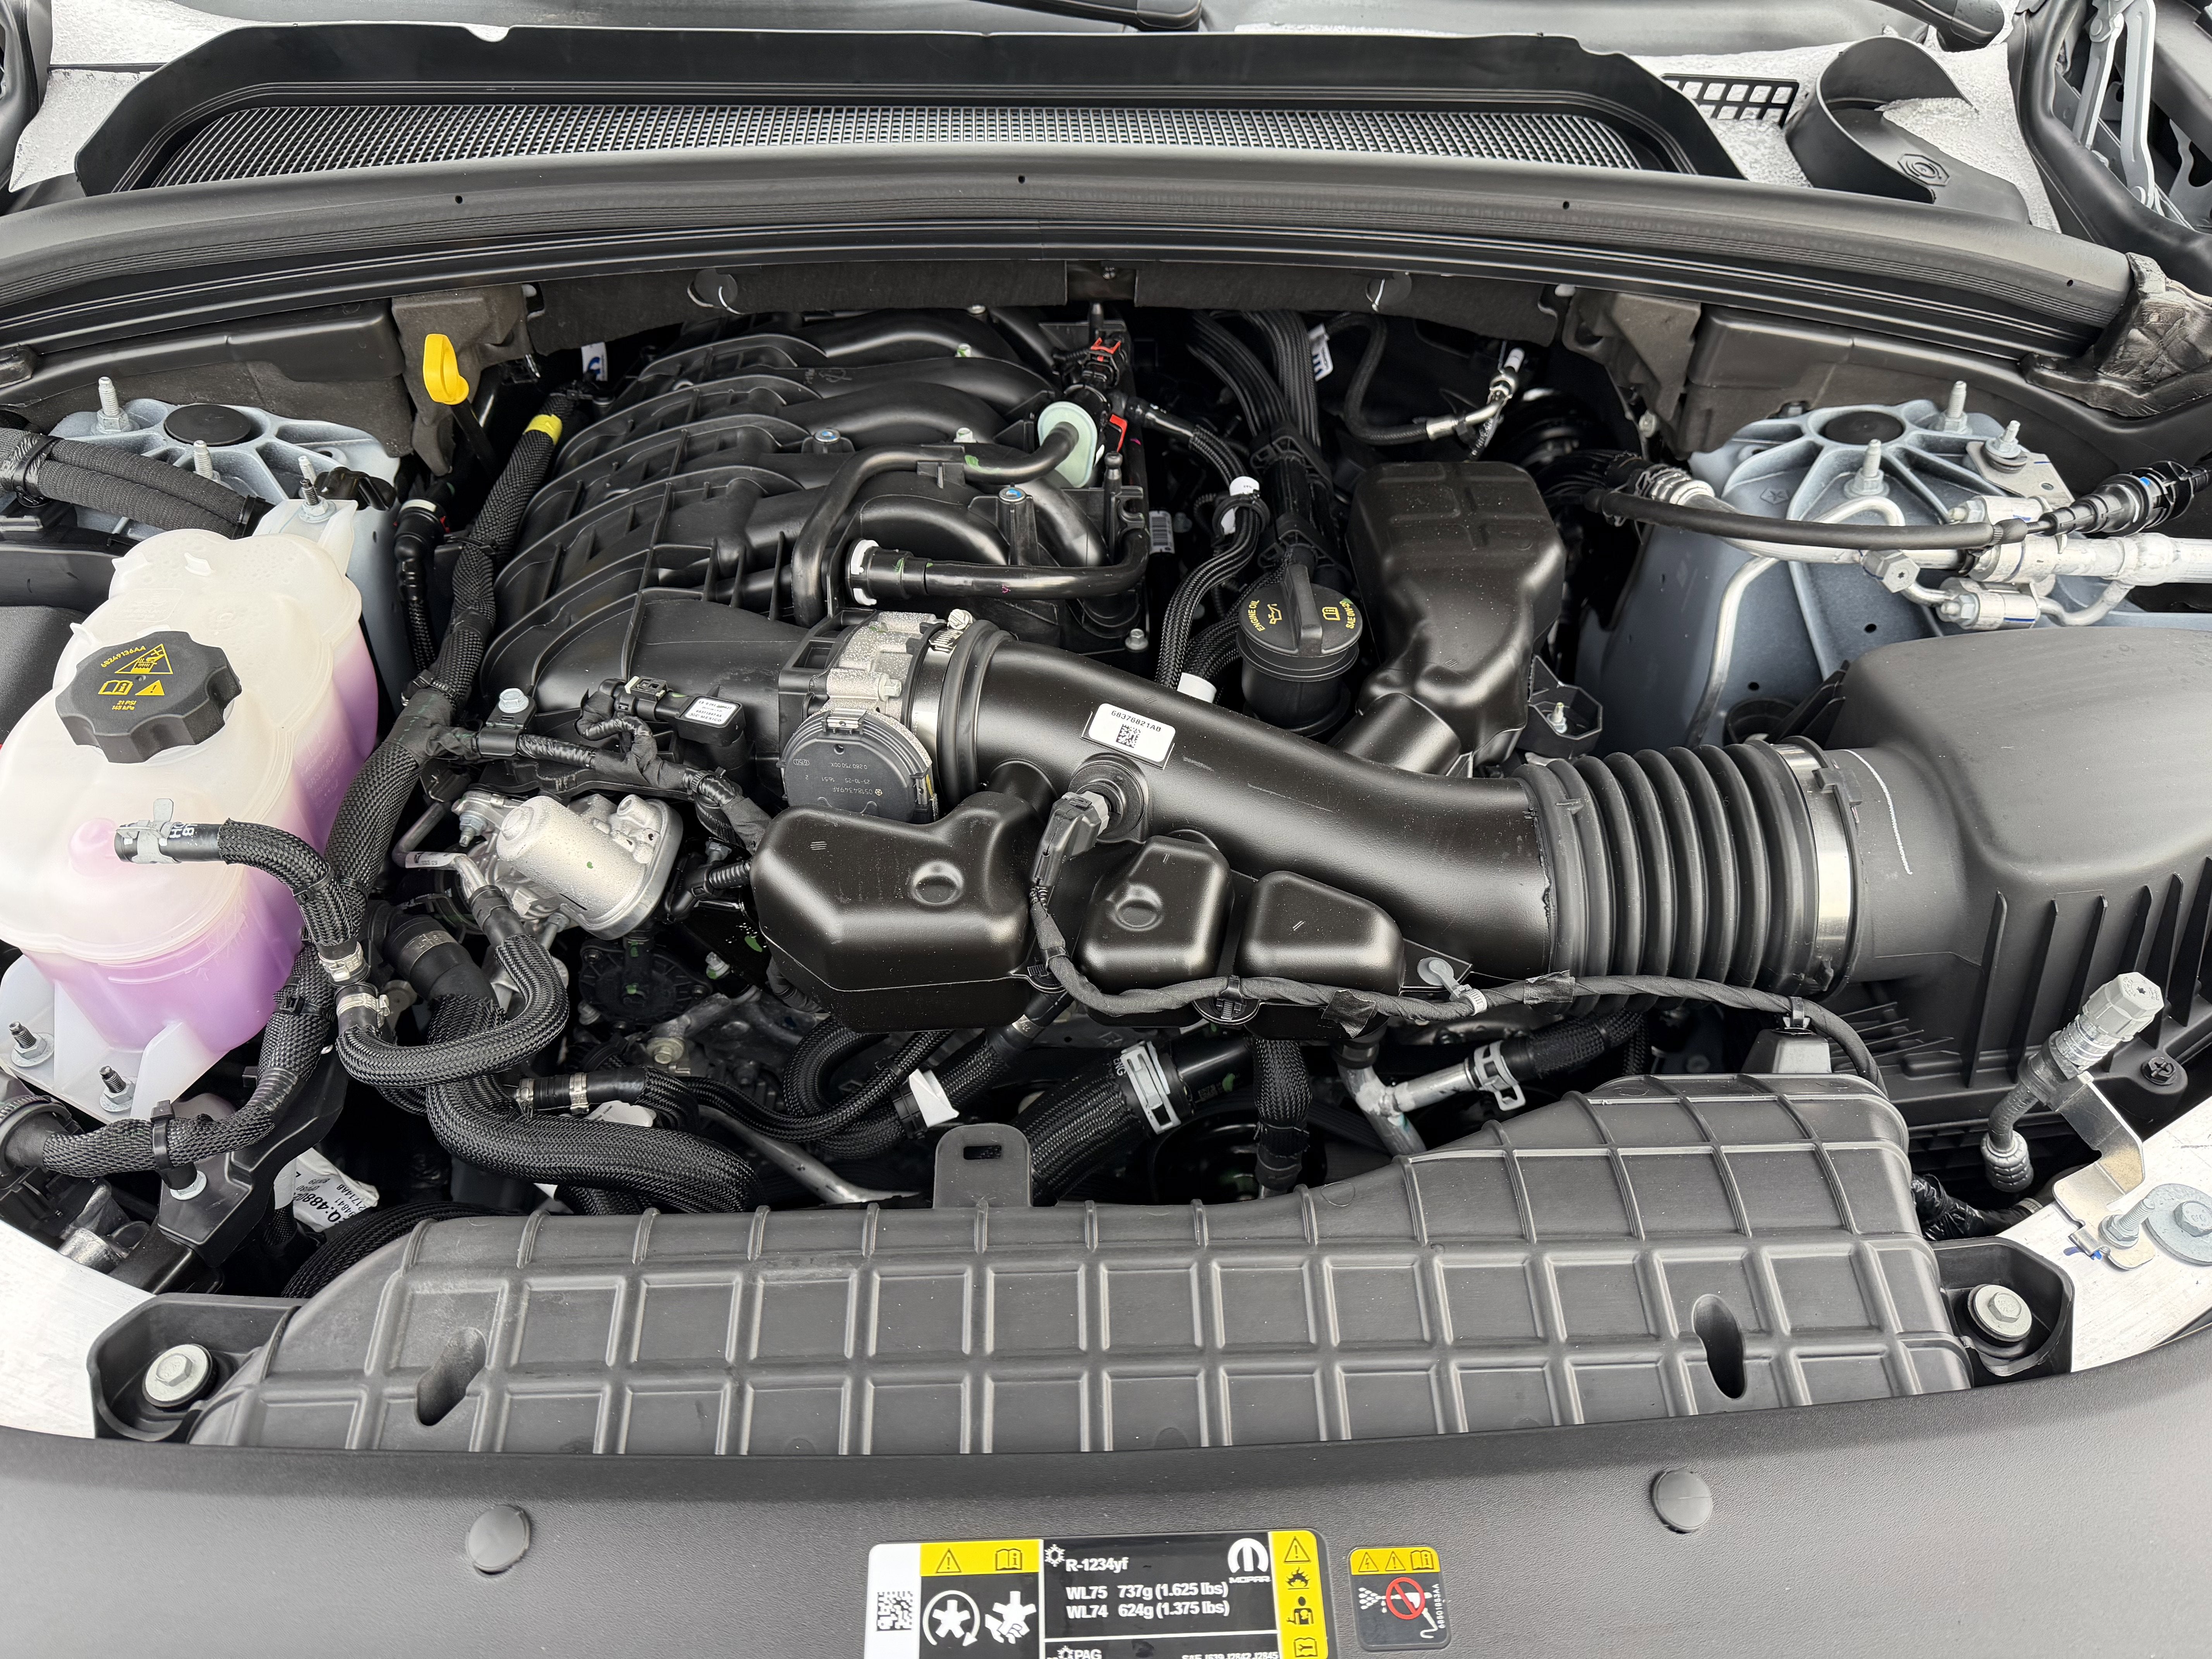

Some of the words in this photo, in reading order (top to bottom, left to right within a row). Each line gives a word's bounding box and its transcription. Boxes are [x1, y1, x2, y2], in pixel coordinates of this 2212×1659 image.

[1249, 600, 1260, 609] OIL
[1248, 610, 1266, 632] ENGINE
[1346, 617, 1356, 629] SAE
[101, 646, 146, 668] 68249136AA
[1111, 710, 1161, 732] 68376821AB
[1066, 1557, 1129, 1573] R-1234yf
[1066, 1586, 1108, 1600] WL75
[1117, 1585, 1153, 1601] 737g
[1155, 1583, 1199, 1600] (1.625
[1201, 1582, 1229, 1598] lbs)
[1066, 1605, 1108, 1619] WL74
[1118, 1603, 1154, 1619] 624g
[1156, 1602, 1200, 1620] (1.375
[1202, 1601, 1230, 1616] lbs)
[1074, 1649, 1103, 1659] PAG
